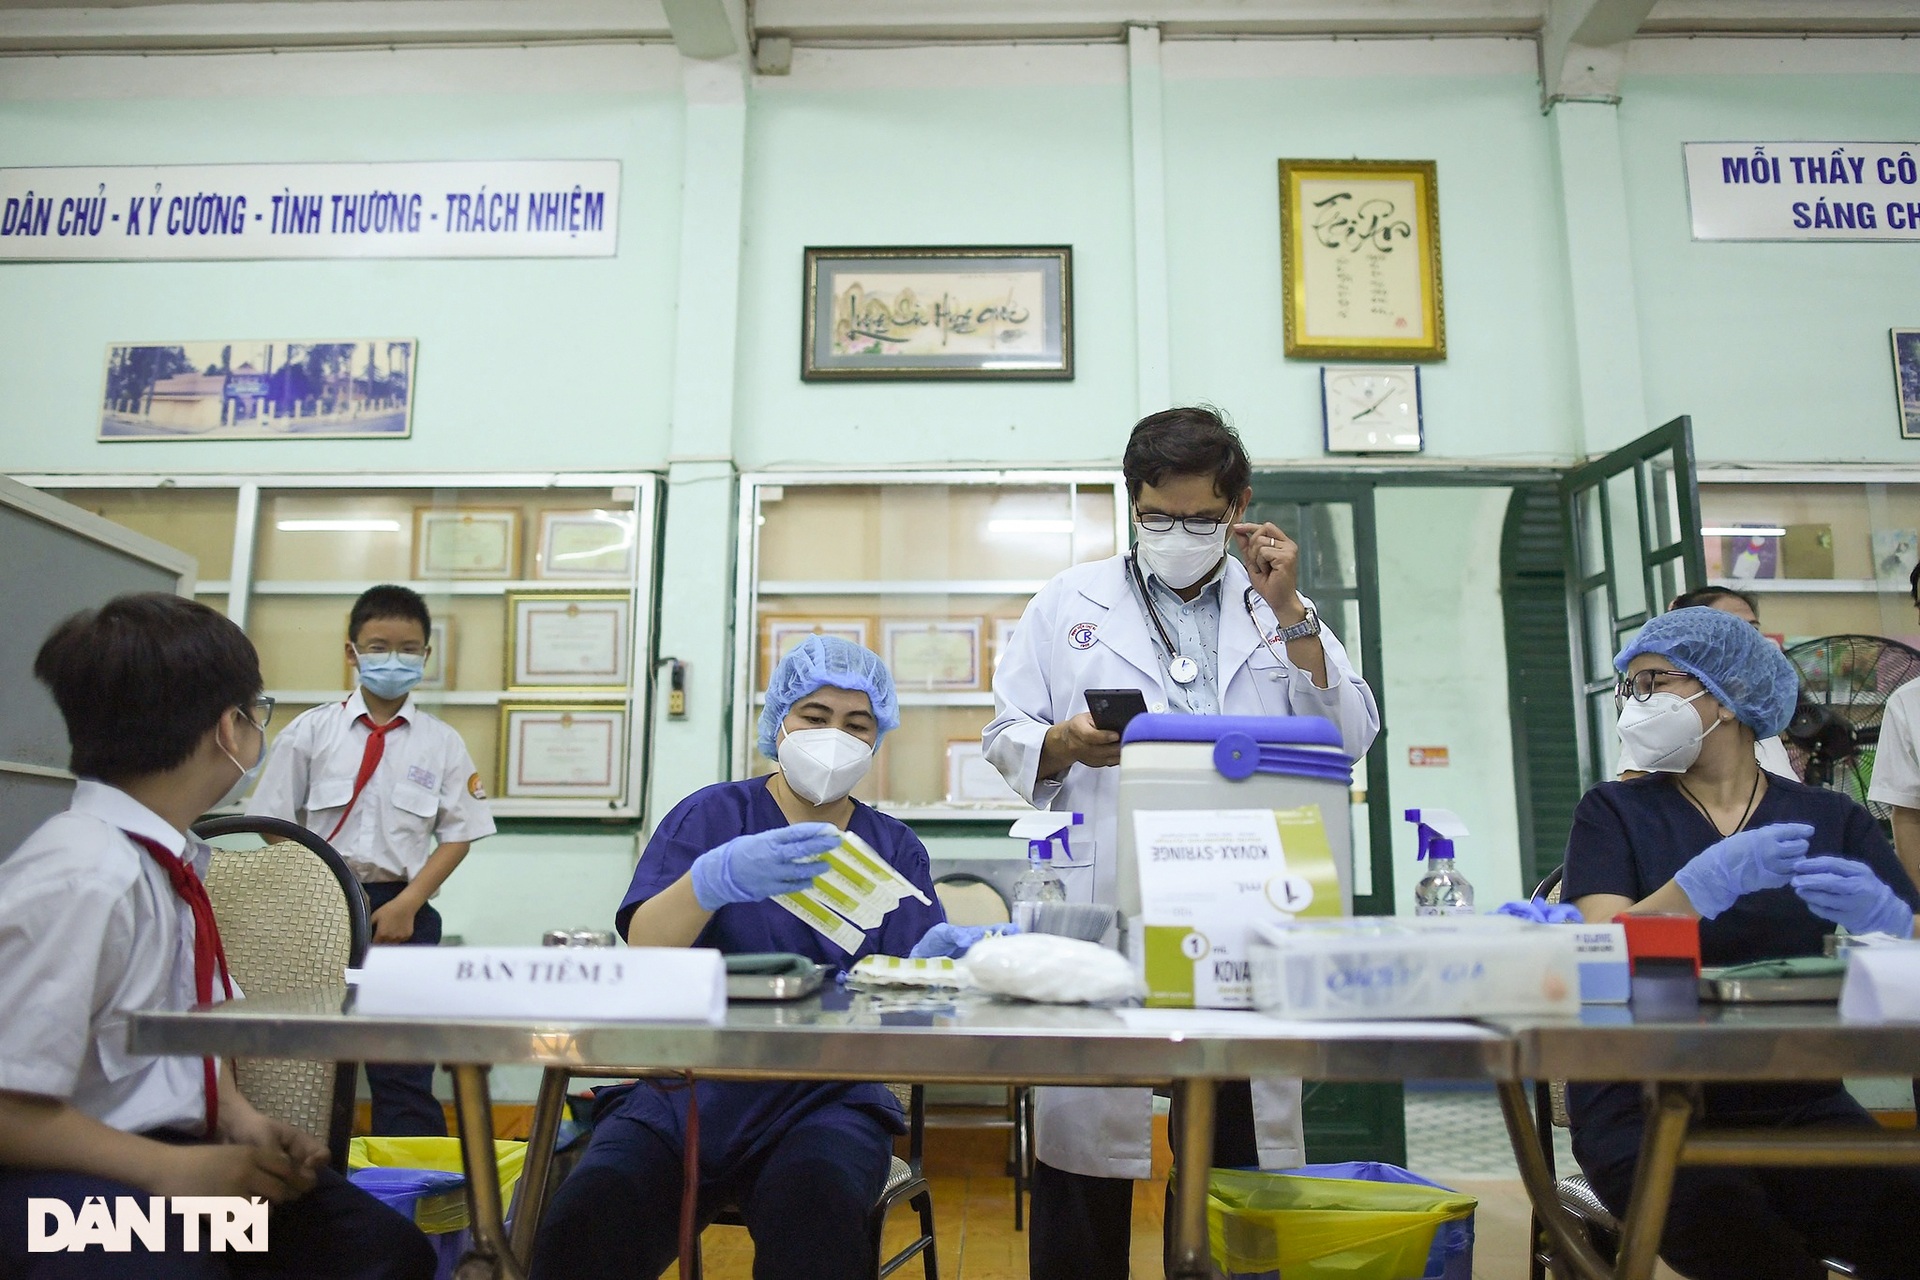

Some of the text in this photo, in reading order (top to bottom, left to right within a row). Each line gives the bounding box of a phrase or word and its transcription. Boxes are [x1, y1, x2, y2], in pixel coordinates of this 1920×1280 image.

[1721, 146, 1918, 185] MỖI THẦY CÔ
[1, 191, 53, 236] DÂN
[57, 183, 107, 236] CHỦ
[126, 183, 163, 235] KỶ
[166, 192, 247, 235] CƯƠNG
[271, 187, 323, 234] TÌNH
[331, 190, 422, 234] THƯƠNG
[445, 185, 520, 233] TRÁCH
[527, 184, 604, 238] NHIỆM
[1792, 196, 1877, 230] SÁNG
[1151, 845, 1269, 861] KOVAX-SYRINGE
[1285, 881, 1299, 904] 1
[1190, 938, 1199, 954] 1
[527, 956, 602, 983] TIÊM
[609, 962, 624, 984] 3
